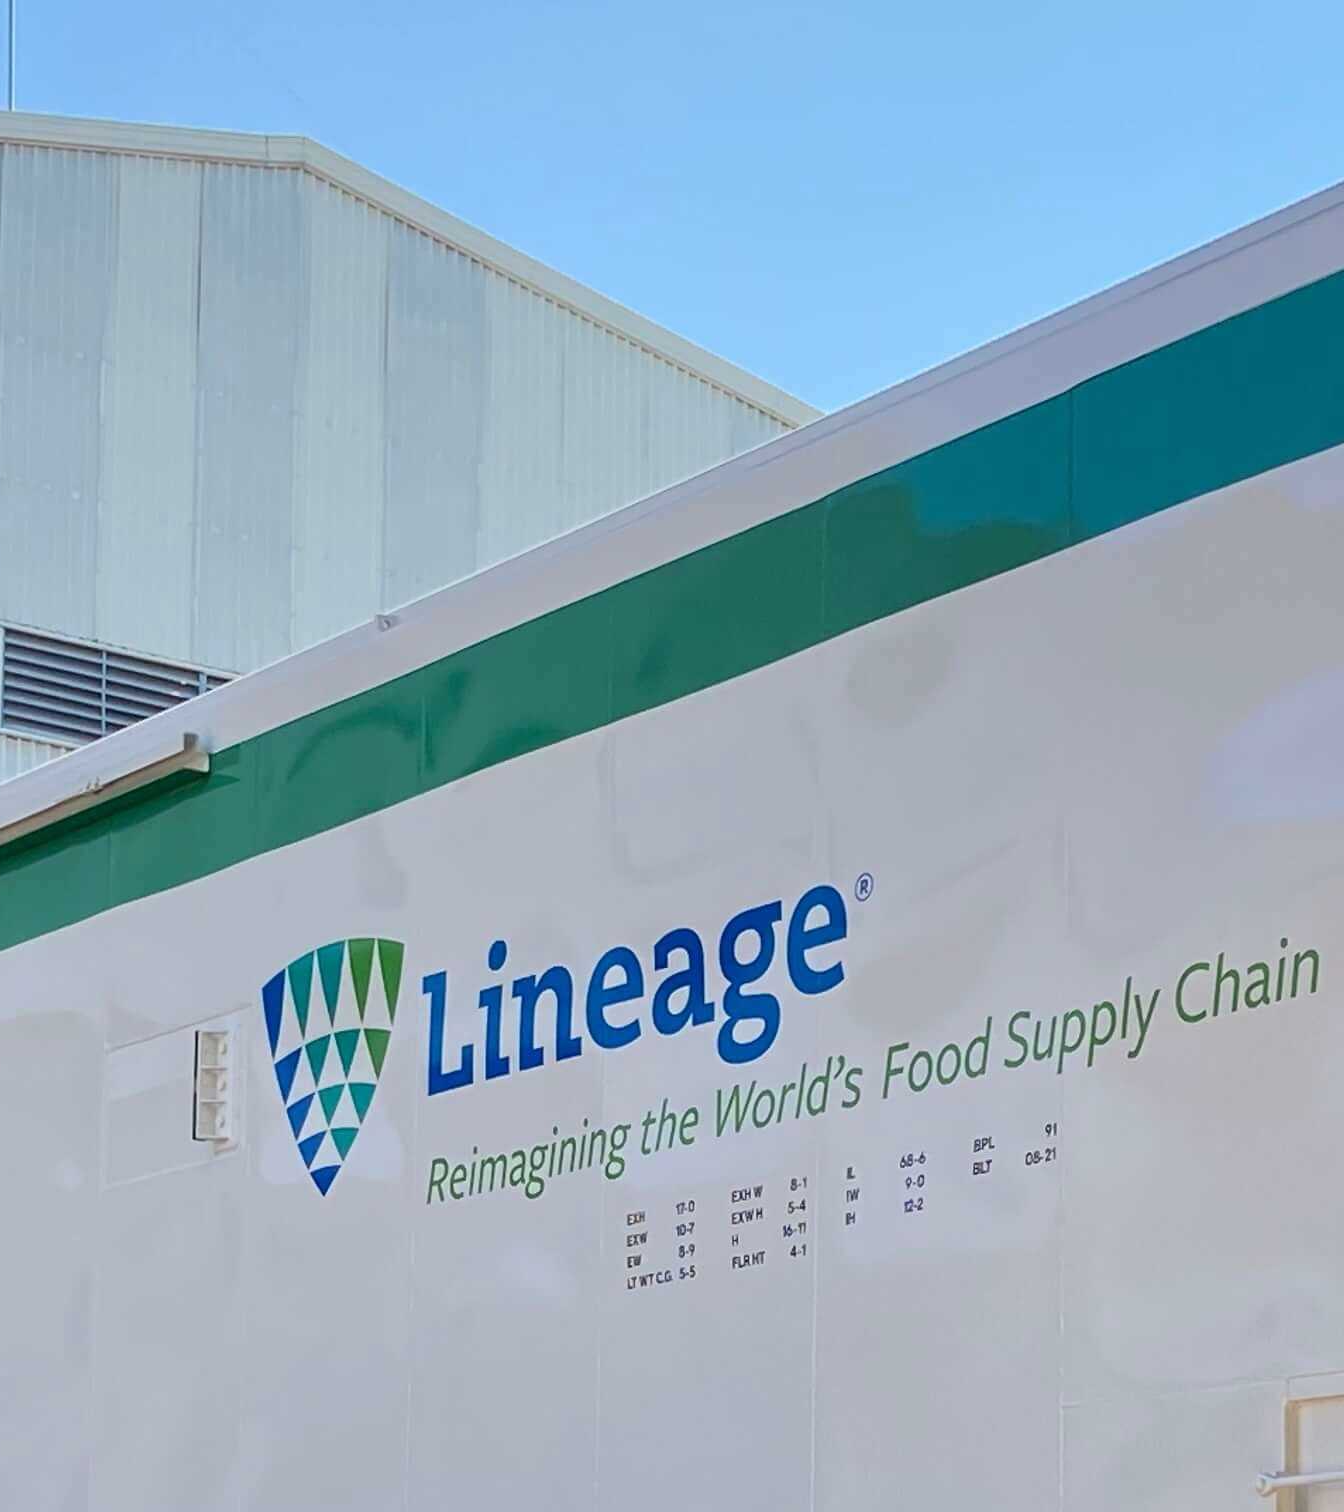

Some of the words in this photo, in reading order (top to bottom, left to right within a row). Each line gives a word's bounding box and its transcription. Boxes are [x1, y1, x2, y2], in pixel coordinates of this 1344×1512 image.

[426, 1118, 631, 1205] Reimagining
[641, 1098, 700, 1156] the
[716, 1054, 864, 1139] World's
[882, 1016, 993, 1100] Food
[1004, 976, 1161, 1074] Supply
[1175, 937, 1321, 1023] Chain
[973, 1137, 995, 1152] BPL
[1045, 1123, 1058, 1137] 91
[899, 1152, 926, 1168] 68-6
[973, 1160, 992, 1175] BLT
[1025, 1147, 1057, 1166] 08-21
[731, 1191, 751, 1203] EXH
[790, 1177, 807, 1191] 8-1
[905, 1174, 925, 1190] 9-0
[627, 1212, 646, 1226] EXH
[676, 1200, 696, 1215] 17-0
[731, 1211, 754, 1225] EXW
[756, 1208, 763, 1220] H
[788, 1199, 806, 1214] 5-4
[627, 1232, 648, 1247] EXW
[676, 1222, 696, 1236] 10-7
[731, 1234, 739, 1247] H
[627, 1255, 642, 1268] EW
[678, 1244, 696, 1258] 8-9
[731, 1255, 750, 1269] FLR
[790, 1244, 807, 1258] 4-1
[679, 1265, 697, 1280] 5-5
